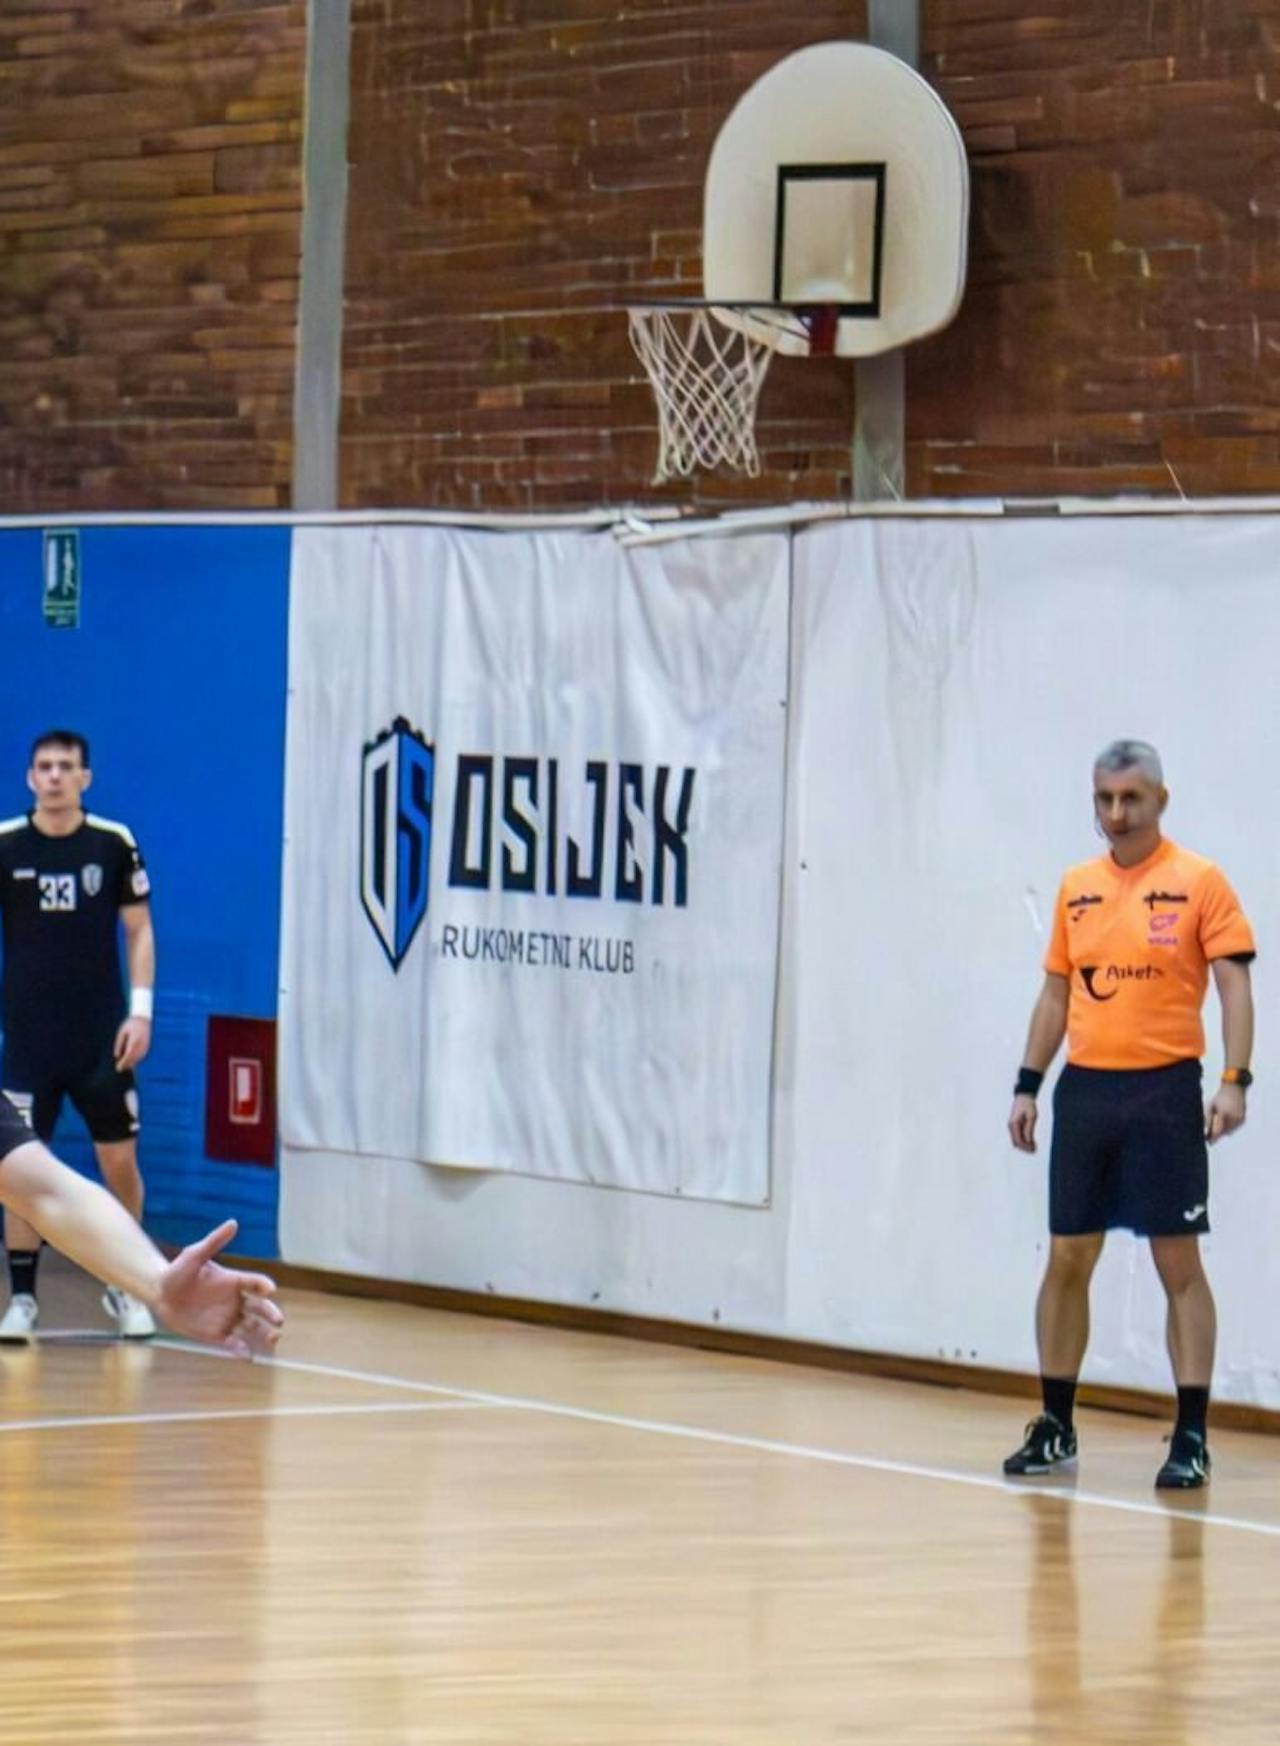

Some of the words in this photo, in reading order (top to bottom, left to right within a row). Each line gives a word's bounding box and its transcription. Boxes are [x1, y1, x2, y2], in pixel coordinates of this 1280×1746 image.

[448, 753, 696, 908] OSIJEK
[39, 874, 76, 911] 33
[442, 925, 571, 969] RUKOMETNI
[578, 937, 634, 974] KLUB
